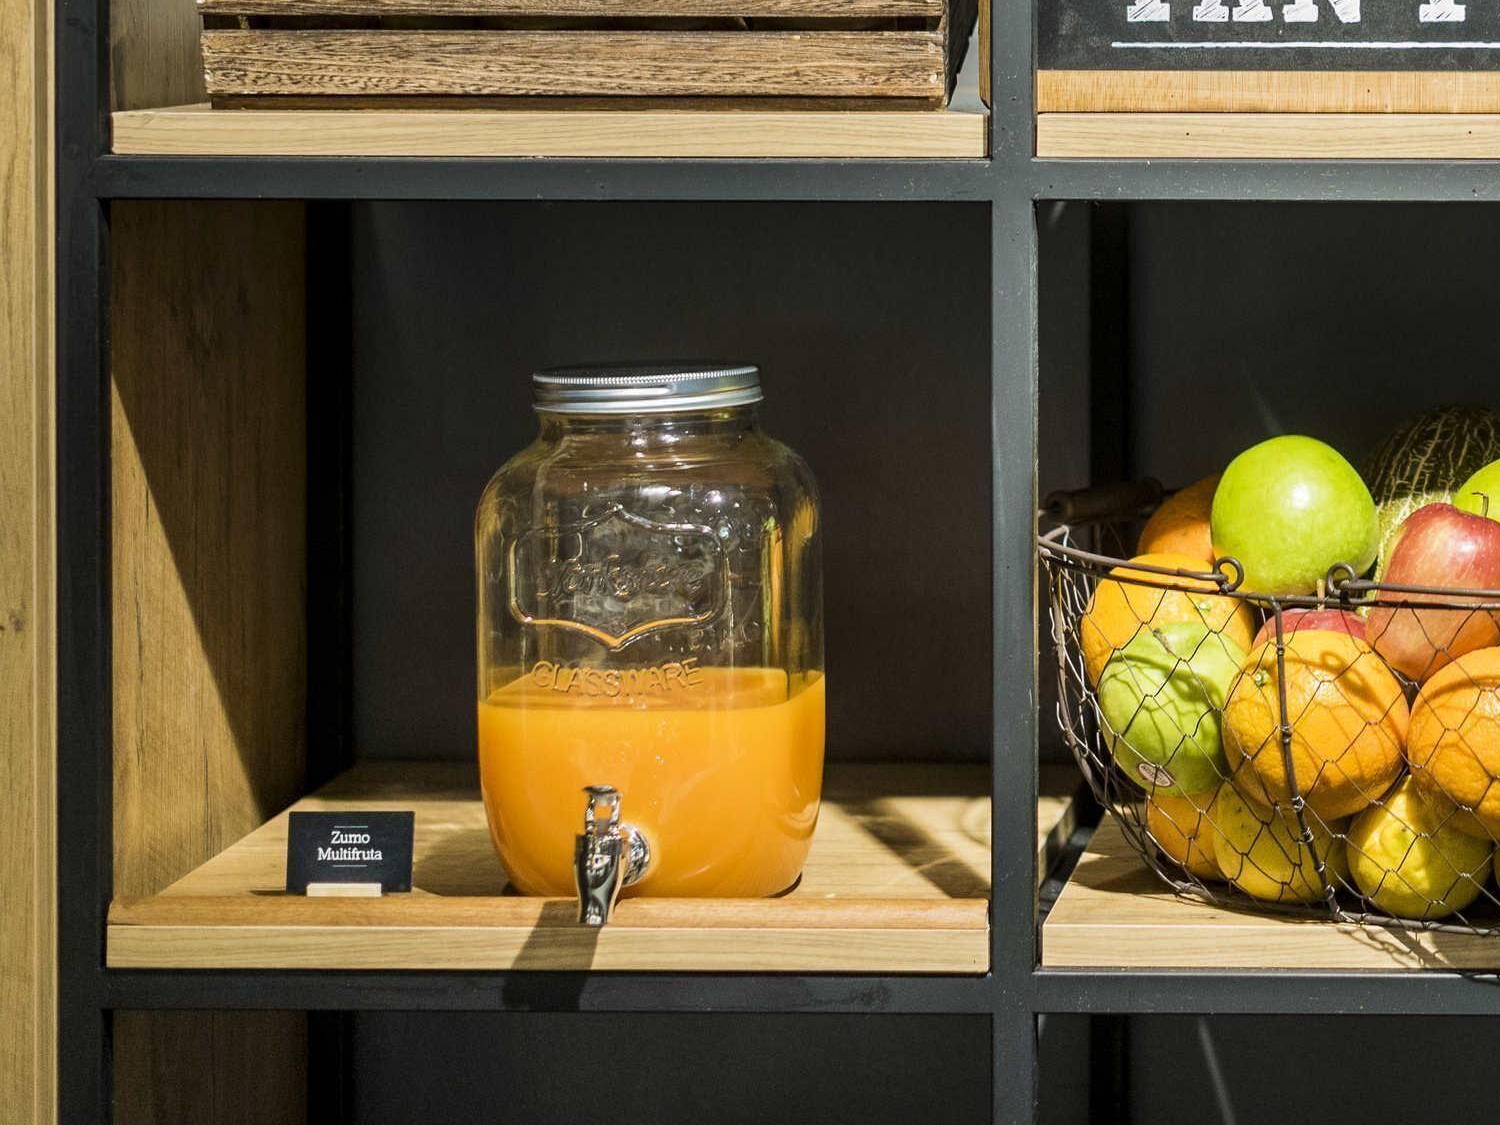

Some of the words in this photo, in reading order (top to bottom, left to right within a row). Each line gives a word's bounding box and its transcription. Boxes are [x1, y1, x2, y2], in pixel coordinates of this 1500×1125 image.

[531, 658, 705, 698] GLASSWARE
[330, 830, 371, 844] Zumo
[317, 847, 383, 862] Multifruta
